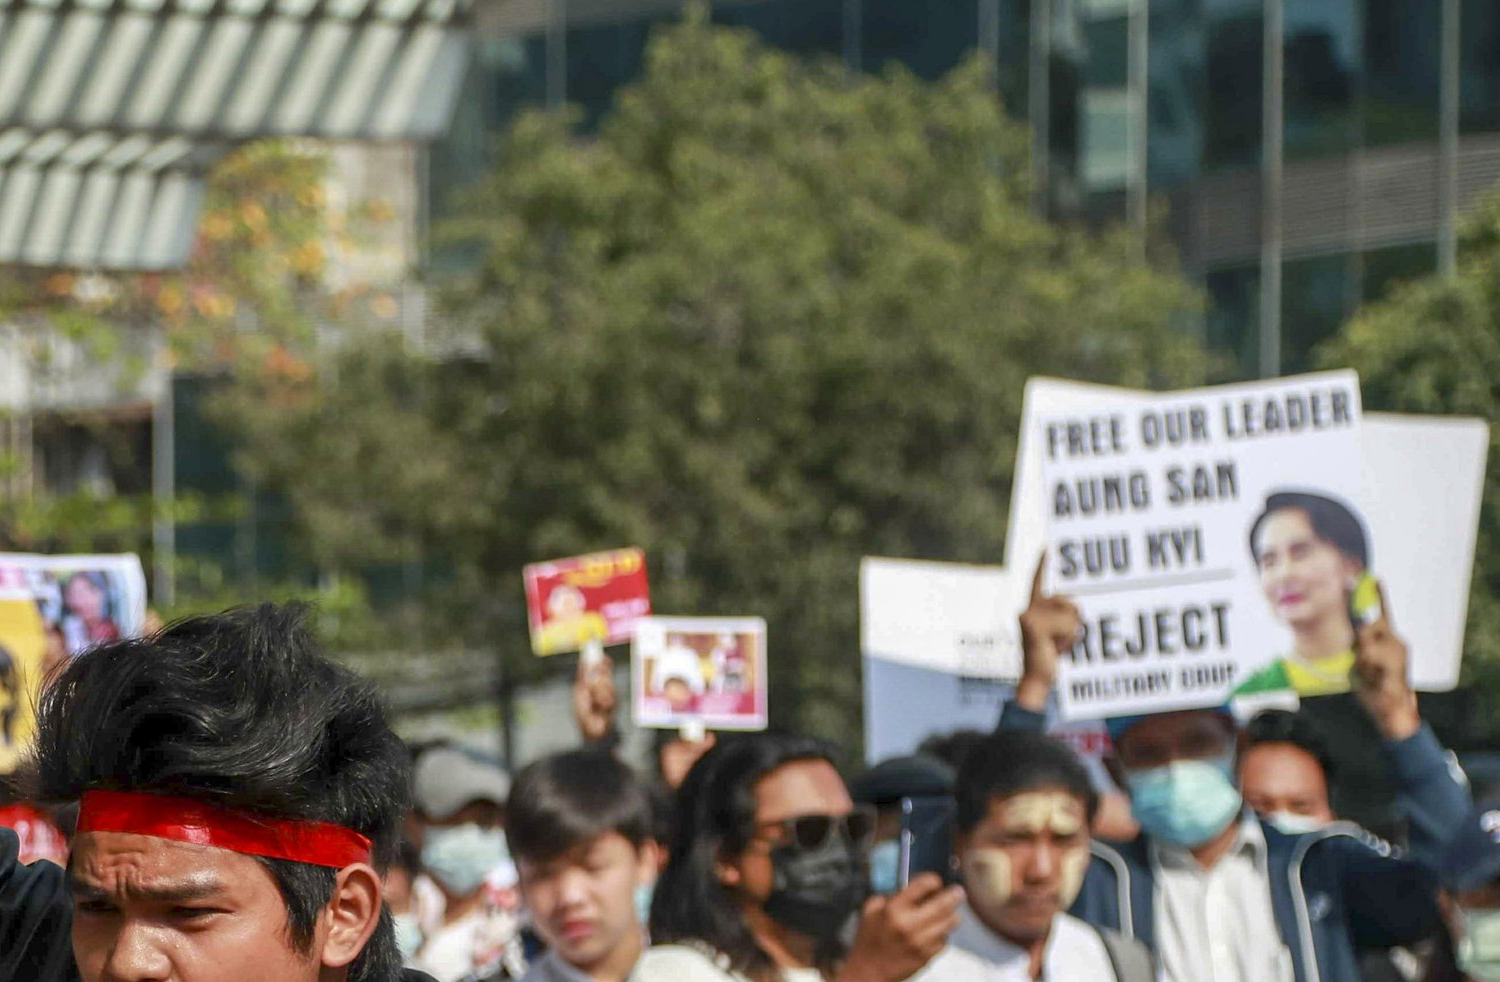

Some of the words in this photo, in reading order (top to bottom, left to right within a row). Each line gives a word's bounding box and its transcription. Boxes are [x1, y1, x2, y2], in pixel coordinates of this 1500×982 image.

[1045, 414, 1124, 460] FREE
[1139, 404, 1208, 448] OUR
[1223, 389, 1351, 440] LEADER
[1053, 470, 1150, 518] AUNG
[1166, 460, 1238, 505] SAN
[1059, 533, 1132, 580] SUU
[1147, 526, 1205, 569] KYI
[1071, 602, 1231, 664] REJECT
[1072, 669, 1171, 701] MILITARY
